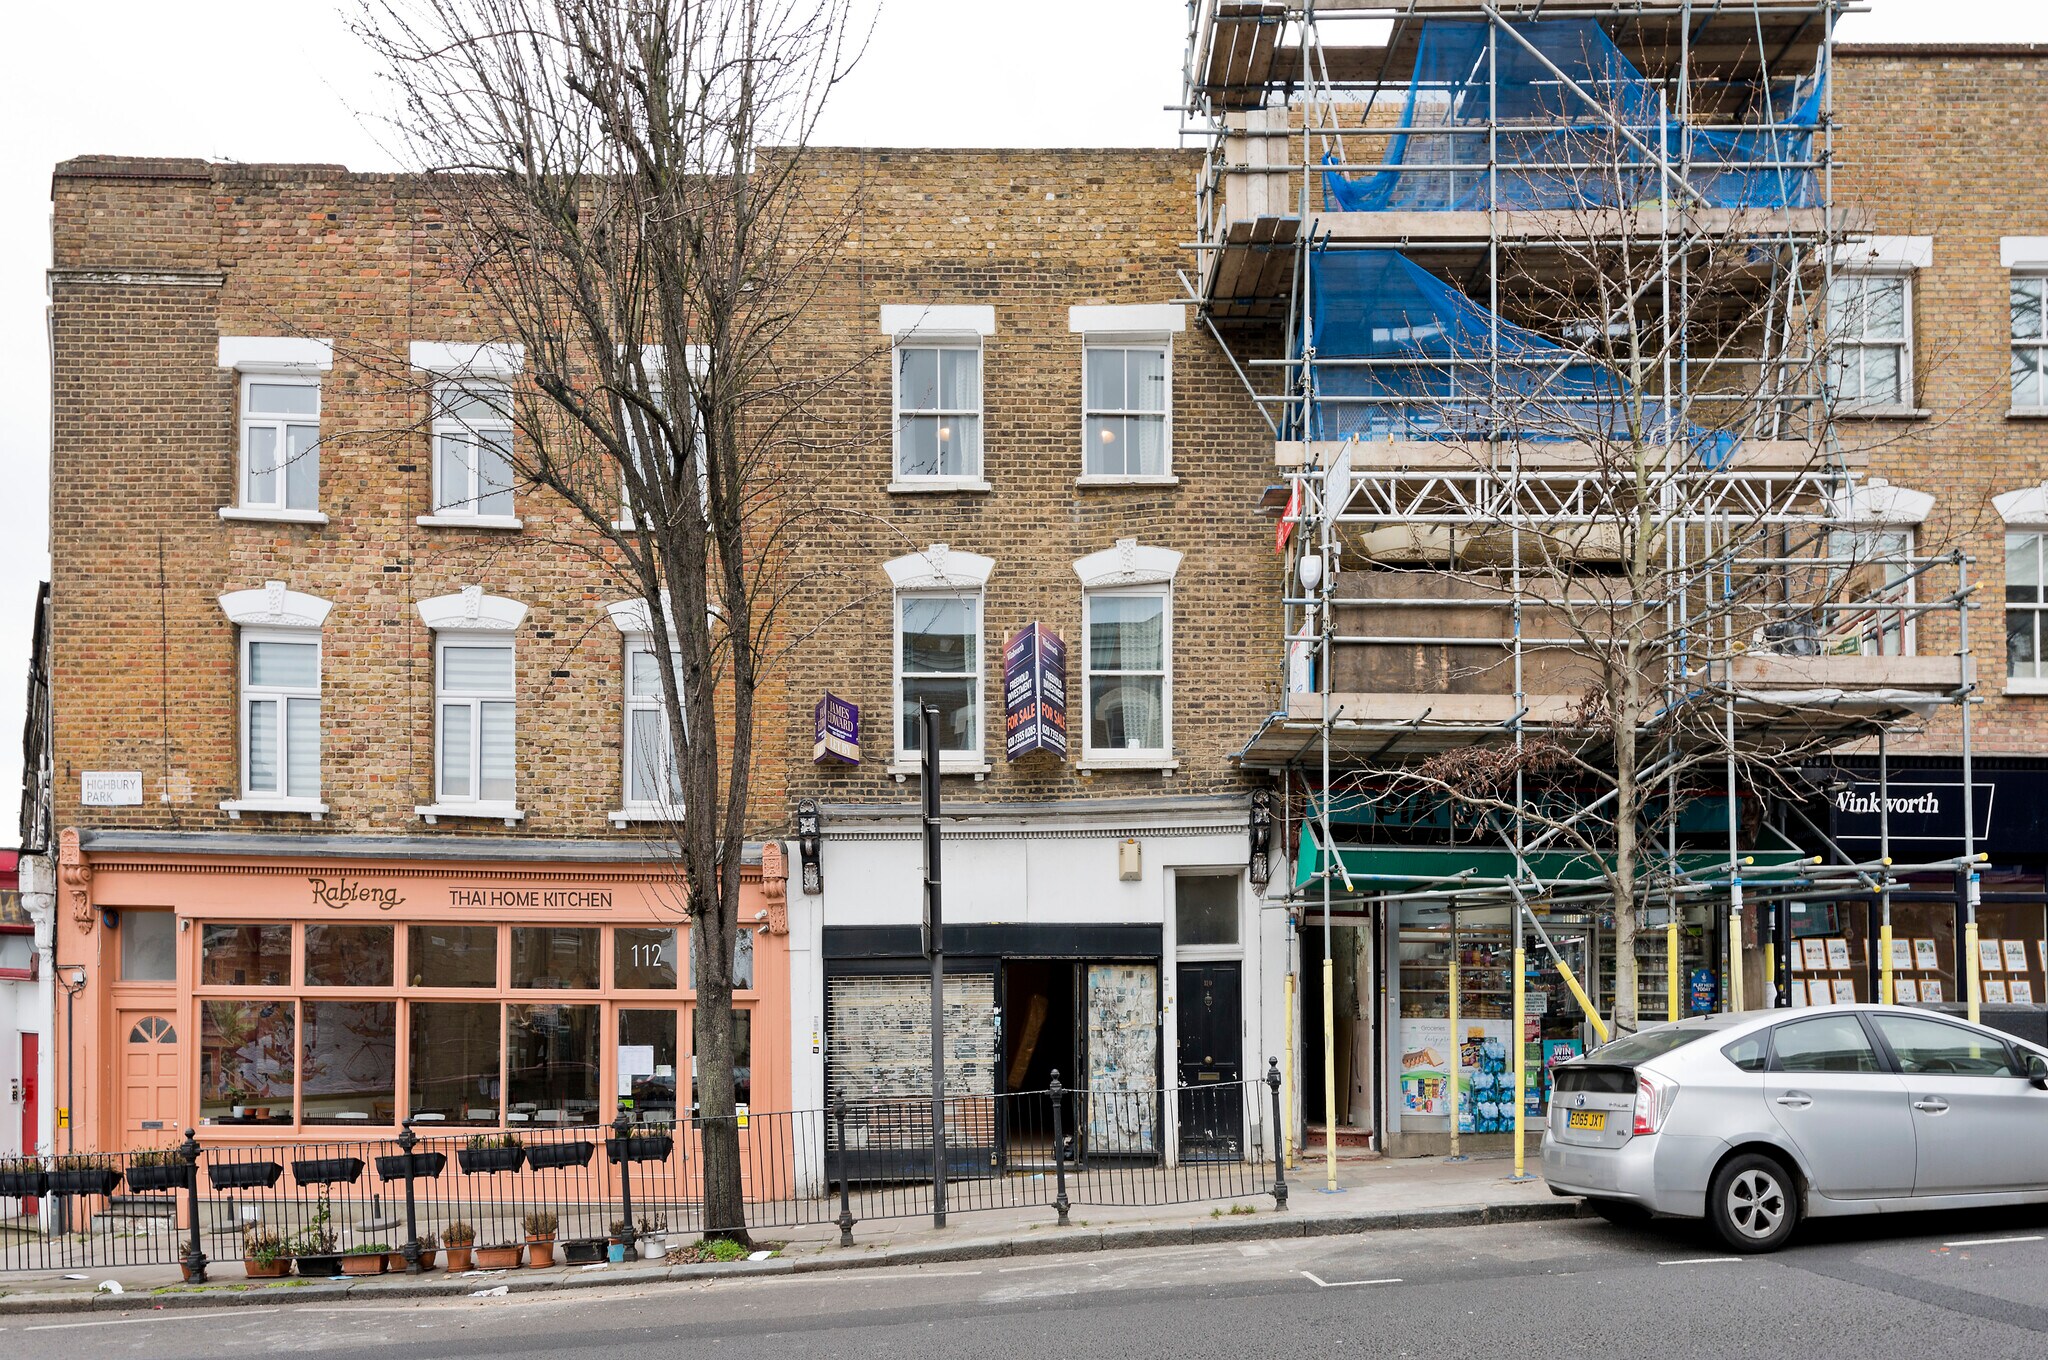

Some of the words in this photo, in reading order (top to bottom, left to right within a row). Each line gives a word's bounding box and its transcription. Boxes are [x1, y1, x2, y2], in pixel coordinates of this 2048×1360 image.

[830, 701, 850, 719] JAMES
[1007, 713, 1019, 731] FOR
[1019, 702, 1036, 724] SALE
[1042, 702, 1053, 722] FOR
[1053, 709, 1066, 730] SALE
[828, 711, 854, 732] EDWARD
[829, 737, 841, 752] LET
[841, 743, 851, 756] BY
[86, 779, 136, 790] HIGHBURY
[86, 791, 113, 802] PARK
[308, 878, 406, 911] Rabieng
[450, 890, 486, 907] THAI
[491, 891, 539, 907] HOME
[543, 892, 613, 908] KITCHEN
[631, 944, 662, 967] 112
[1553, 1047, 1571, 1056] WIN
[1571, 1113, 1588, 1127] EO65
[1589, 1115, 1604, 1128] JXT
